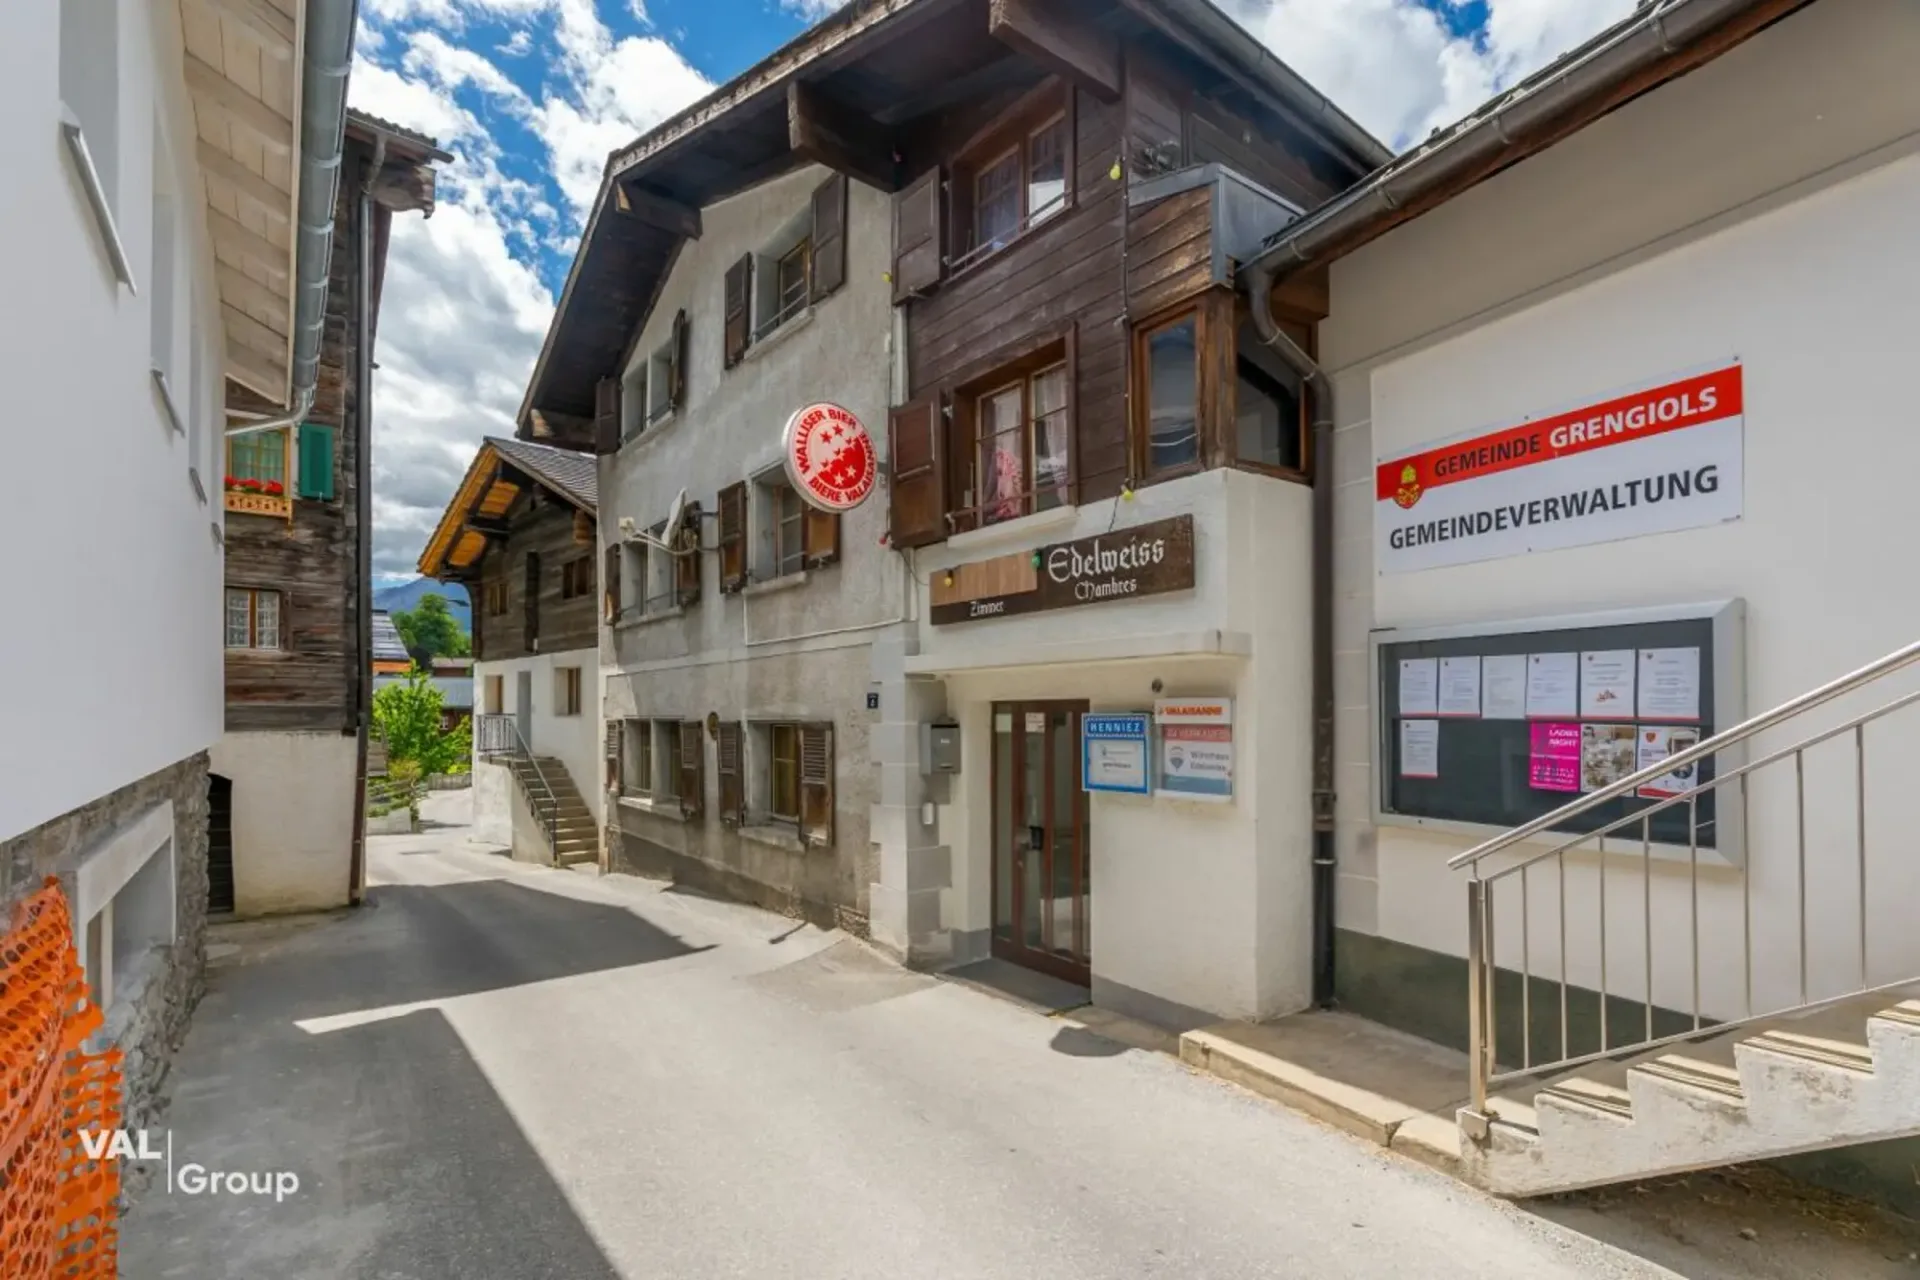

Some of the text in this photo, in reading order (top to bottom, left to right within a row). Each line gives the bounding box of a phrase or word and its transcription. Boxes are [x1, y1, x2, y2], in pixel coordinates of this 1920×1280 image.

[796, 408, 857, 475] WALLISER BIER
[1434, 386, 1718, 477] GEMEINDE GRENGIOLS
[1389, 464, 1719, 551] GEMEINDEVERWALTUNG
[1048, 535, 1166, 583] Edelweiss
[970, 600, 1005, 617] Zimmer
[1090, 721, 1141, 733] HENNIEZ
